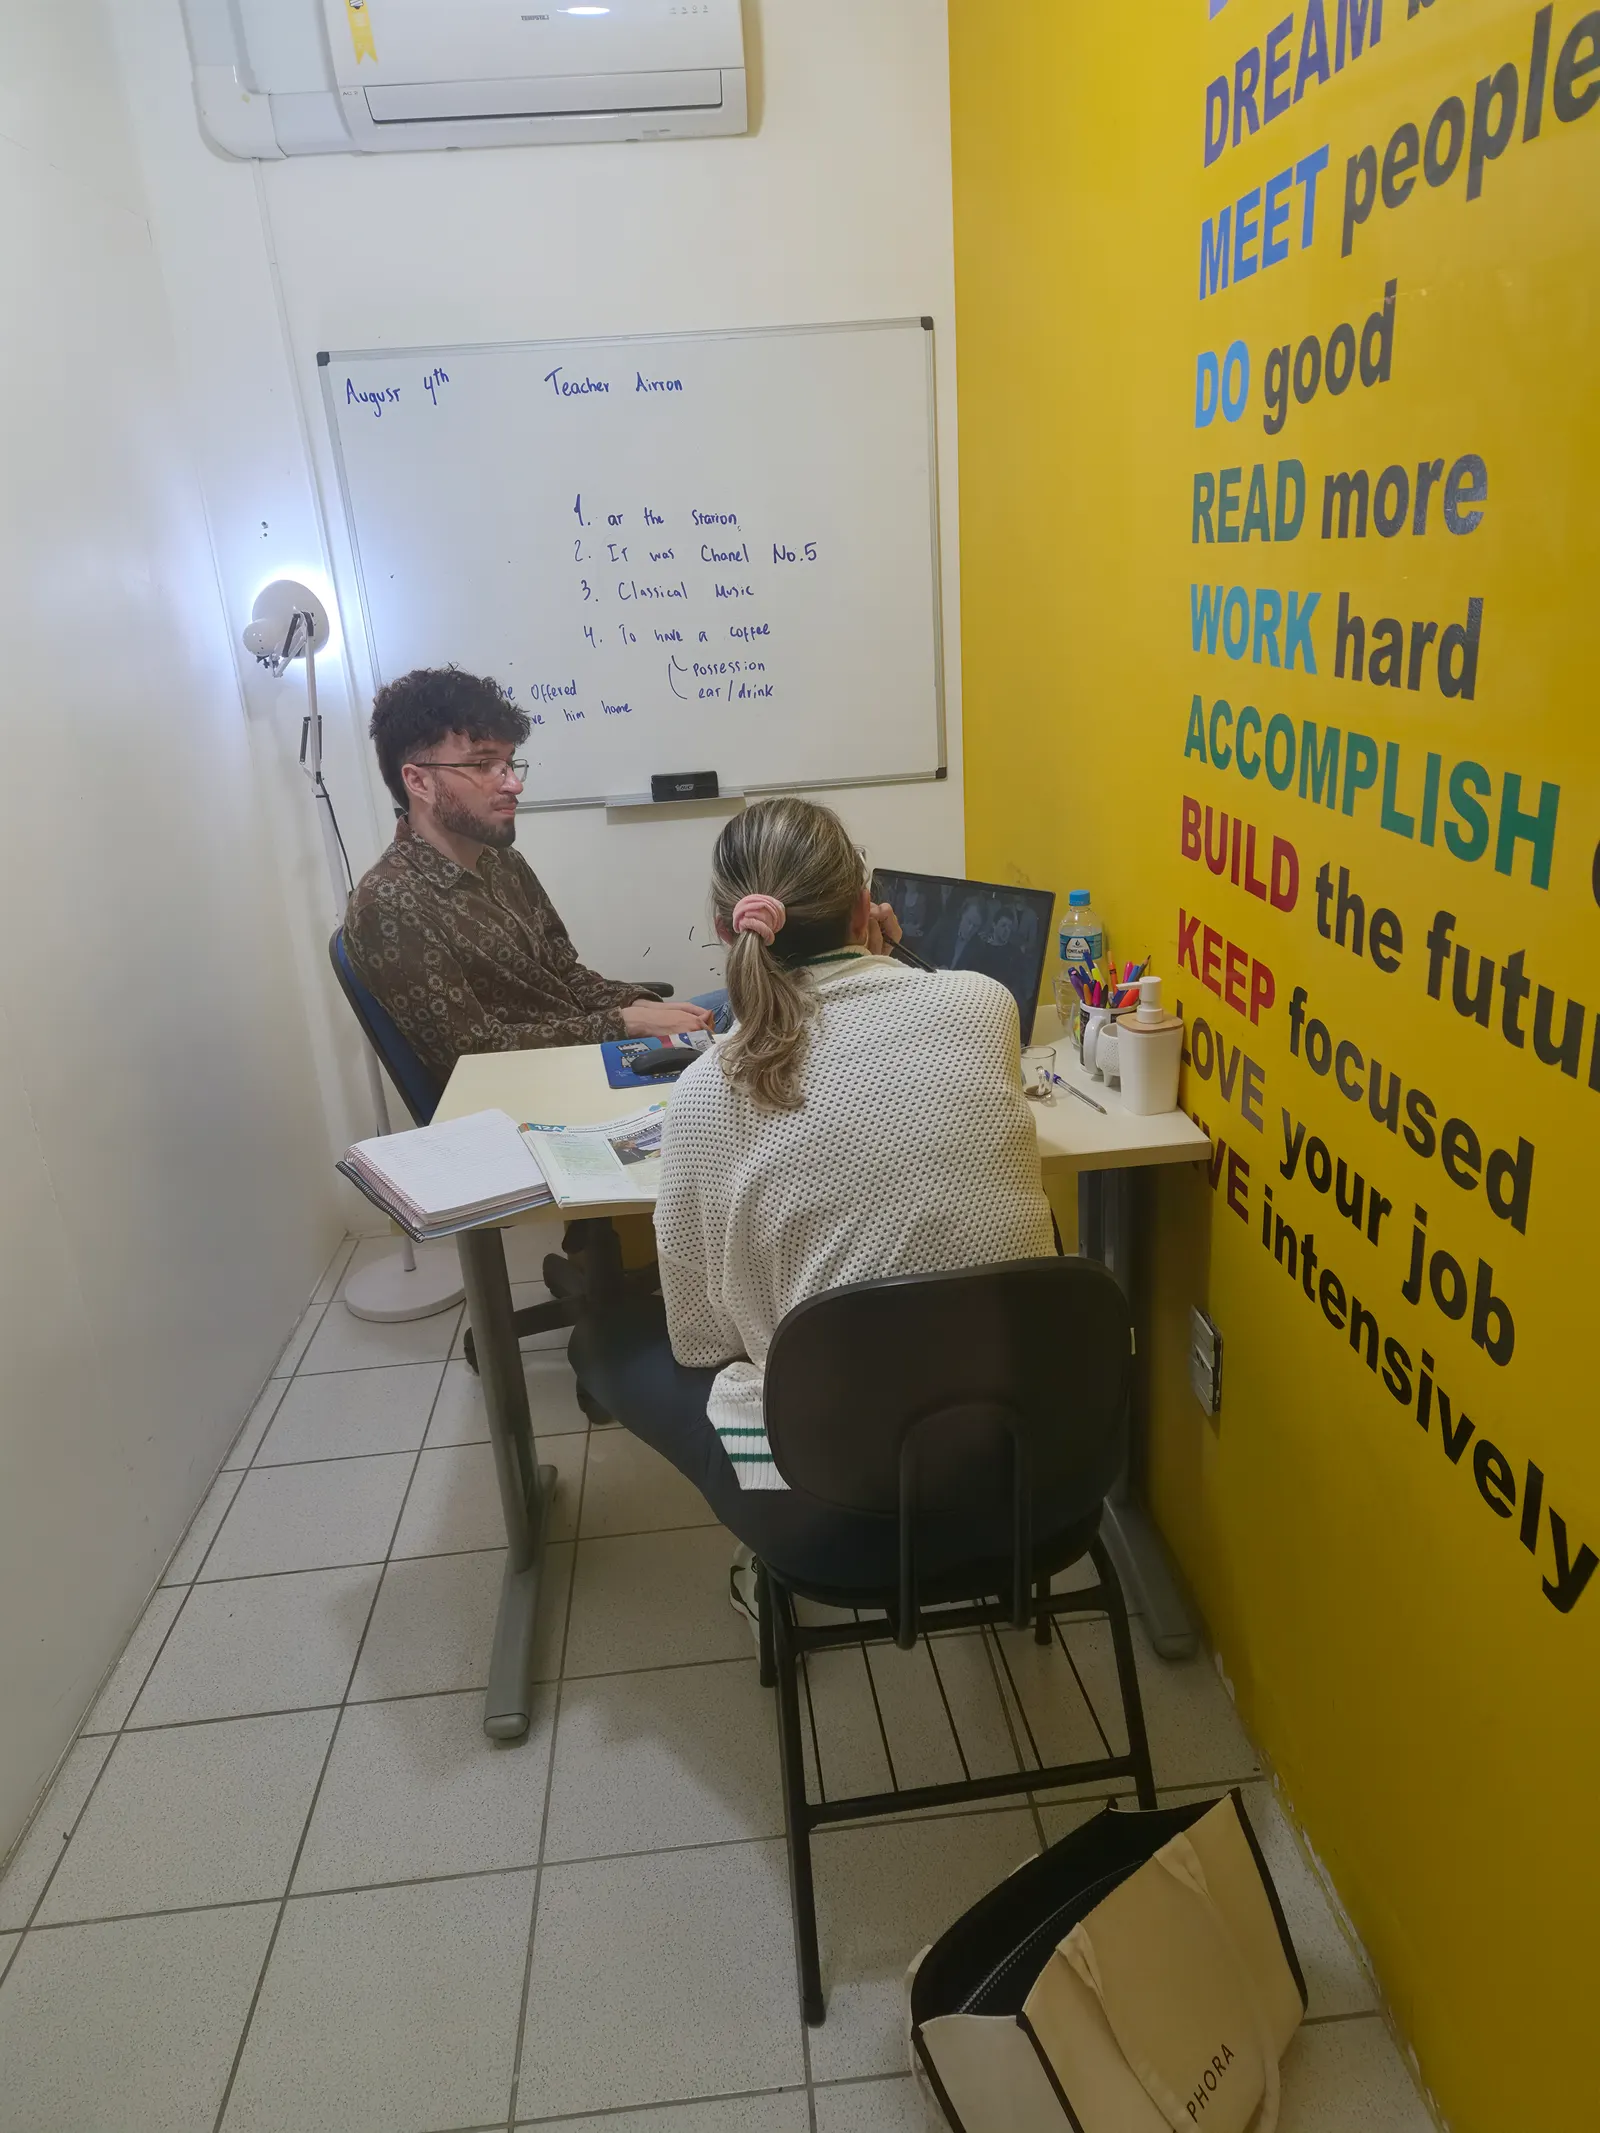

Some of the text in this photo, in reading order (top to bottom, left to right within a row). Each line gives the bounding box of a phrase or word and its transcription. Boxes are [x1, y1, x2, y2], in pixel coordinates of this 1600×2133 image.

[1204, 0, 1382, 168] DREAM
[1200, 3, 1600, 301] MEET people
[423, 368, 450, 405] 4th
[544, 367, 611, 397] Teacher
[1195, 277, 1397, 436] DO good
[643, 506, 665, 527] the
[1191, 453, 1488, 544] READ more
[574, 539, 592, 562] 2.
[649, 547, 675, 562] was
[700, 543, 750, 563] Chanel
[580, 579, 600, 602] 3.
[617, 580, 688, 601] Classical
[583, 625, 603, 648] 4.
[618, 623, 637, 645] To
[653, 628, 684, 643] have
[698, 631, 708, 642] a
[1190, 583, 1484, 701] WORK hard
[562, 708, 586, 722] him
[600, 700, 633, 716] home
[1184, 694, 1561, 891] ACCOMPLISH
[1181, 795, 1300, 913] BUILD
[1315, 861, 1403, 973] the
[1177, 907, 1535, 1236] KEEP focused
[1279, 1106, 1392, 1248] your
[1402, 1203, 1515, 1367] job
[1192, 1112, 1600, 1614] VE intensively
[1186, 2043, 1235, 2124] PHORA
